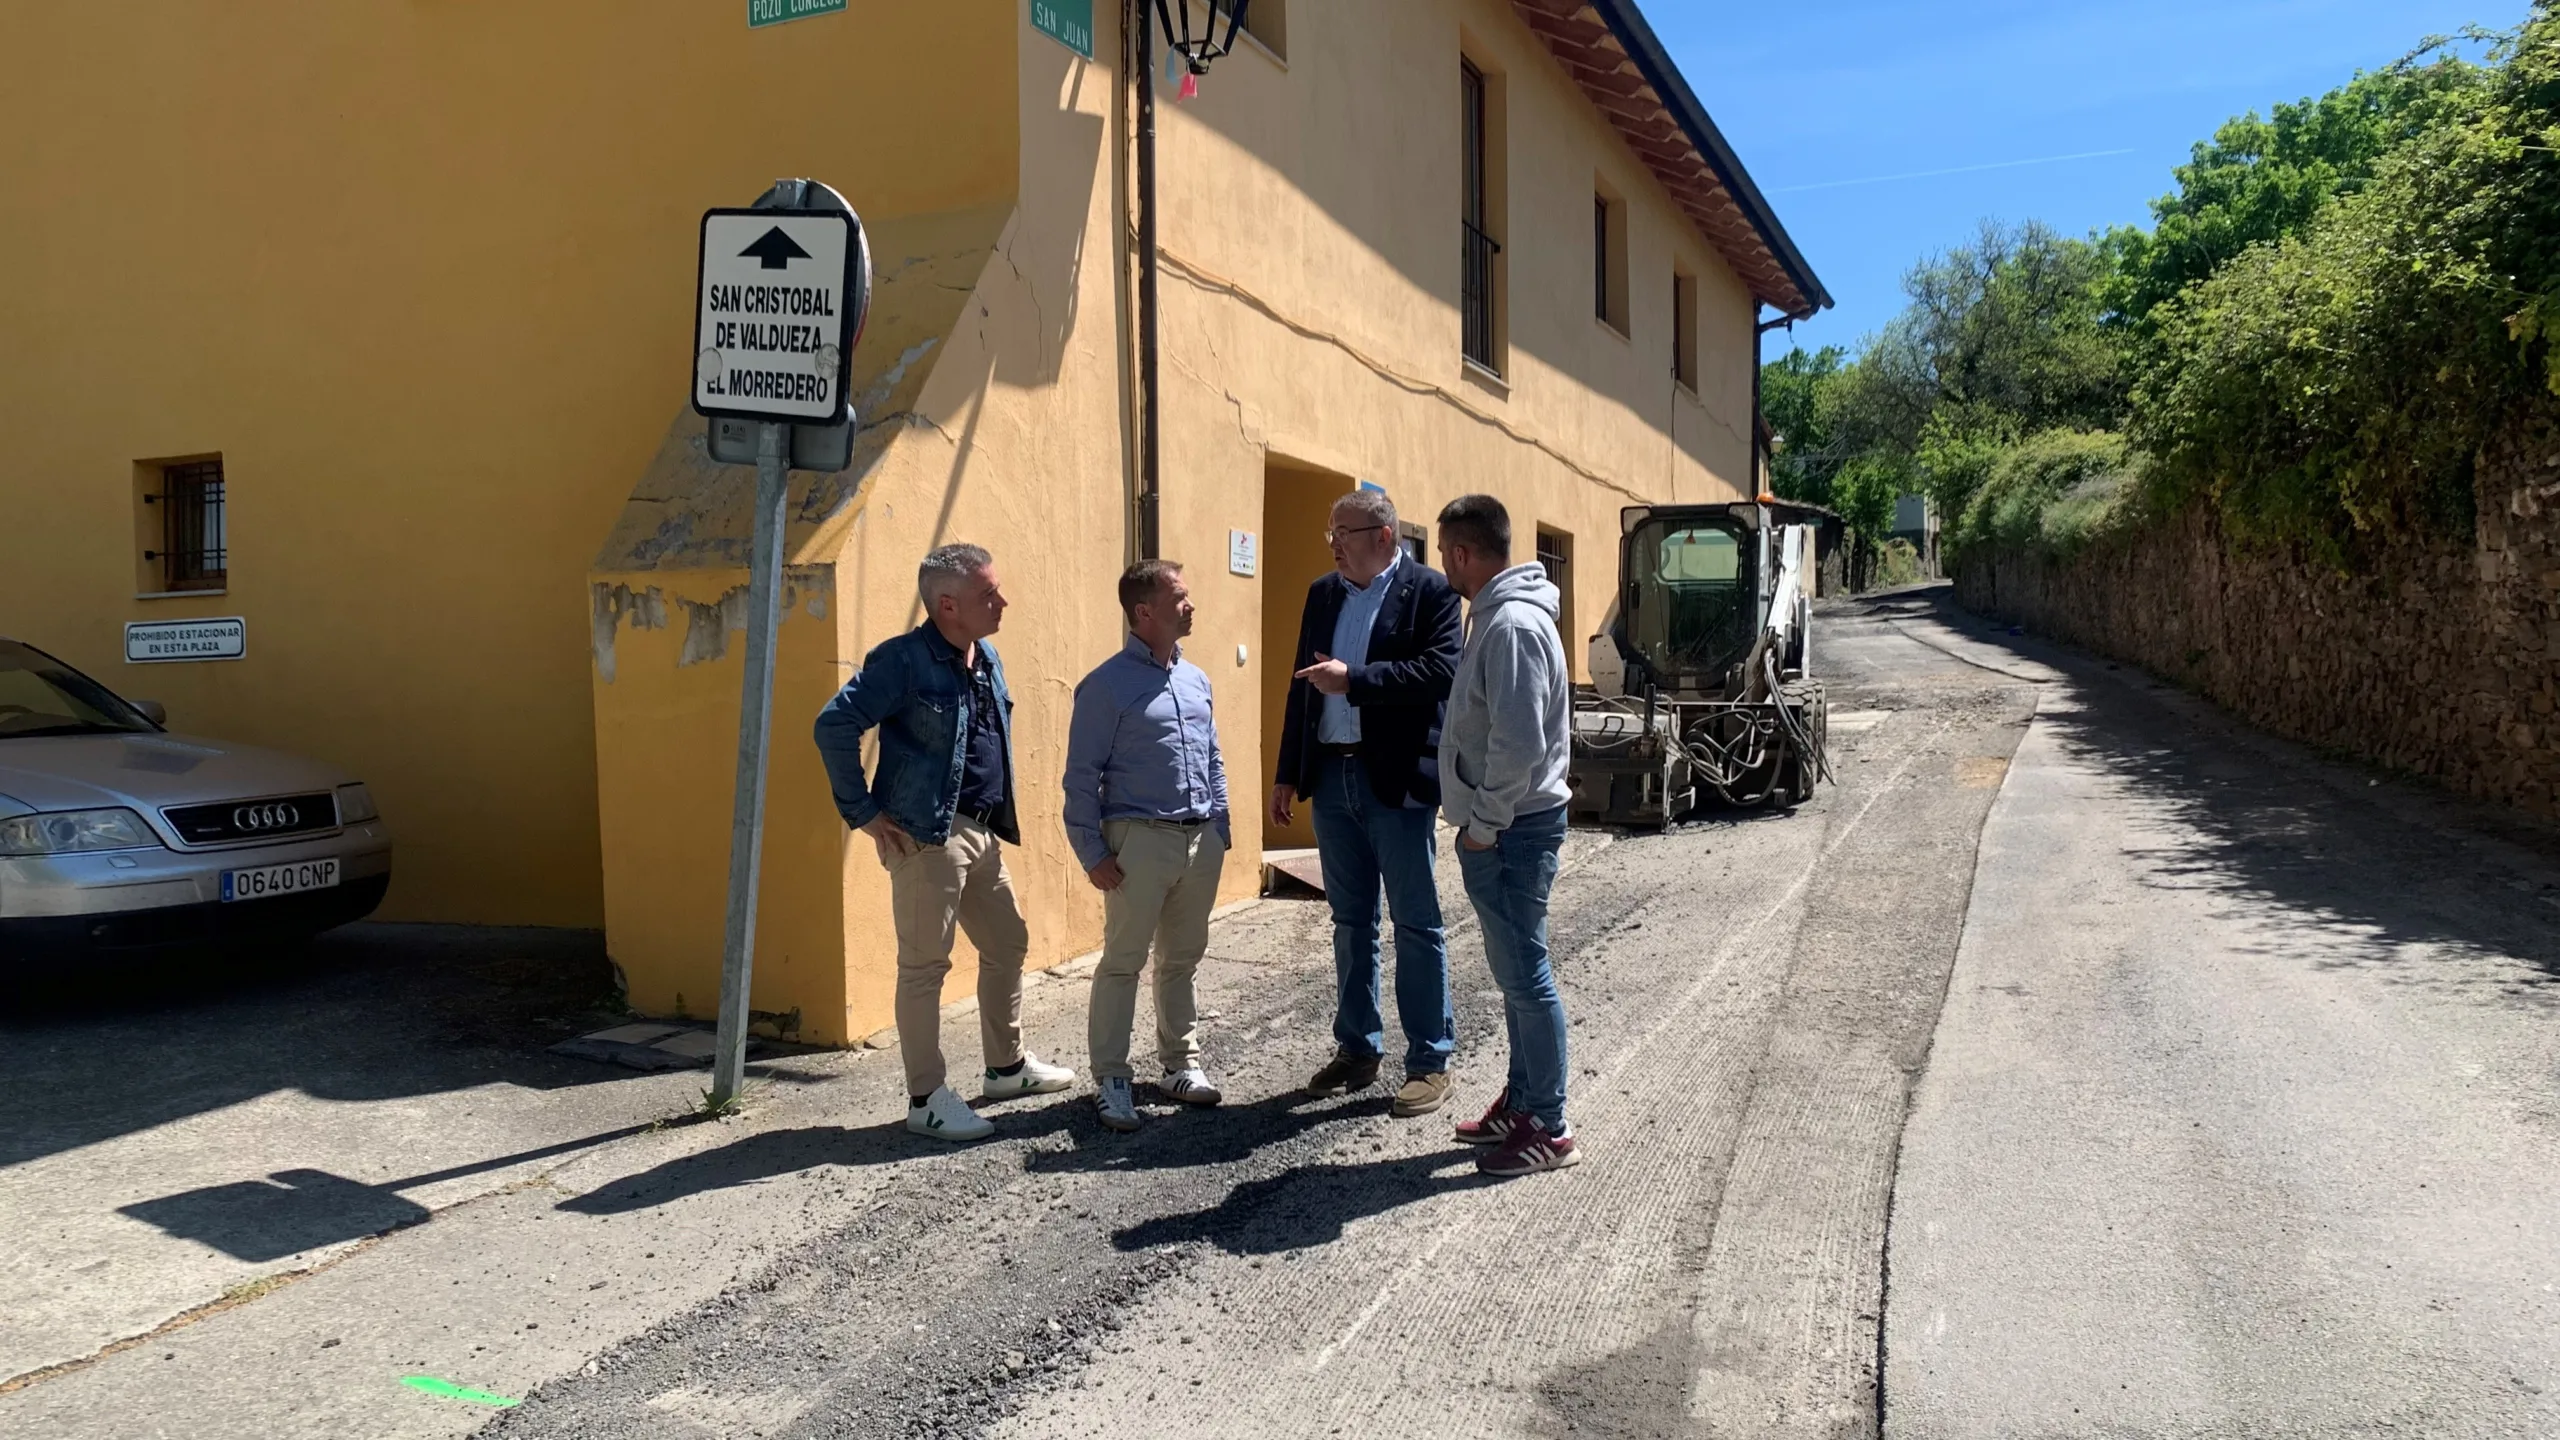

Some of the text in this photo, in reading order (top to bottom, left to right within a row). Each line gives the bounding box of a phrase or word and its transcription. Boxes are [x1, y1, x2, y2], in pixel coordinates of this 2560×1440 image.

[754, 0, 782, 21] POZO
[1036, 2, 1088, 52] SAN JUAN
[710, 284, 834, 316] SAN CRISTOBAL
[716, 322, 822, 354] DE VALDUEZA
[729, 369, 828, 403] MORREDERO
[129, 627, 240, 642] PROHIBIDO ESTACIONAR
[149, 642, 220, 654] EN ESTA PLAZA
[238, 862, 335, 895] 0640 CNP
